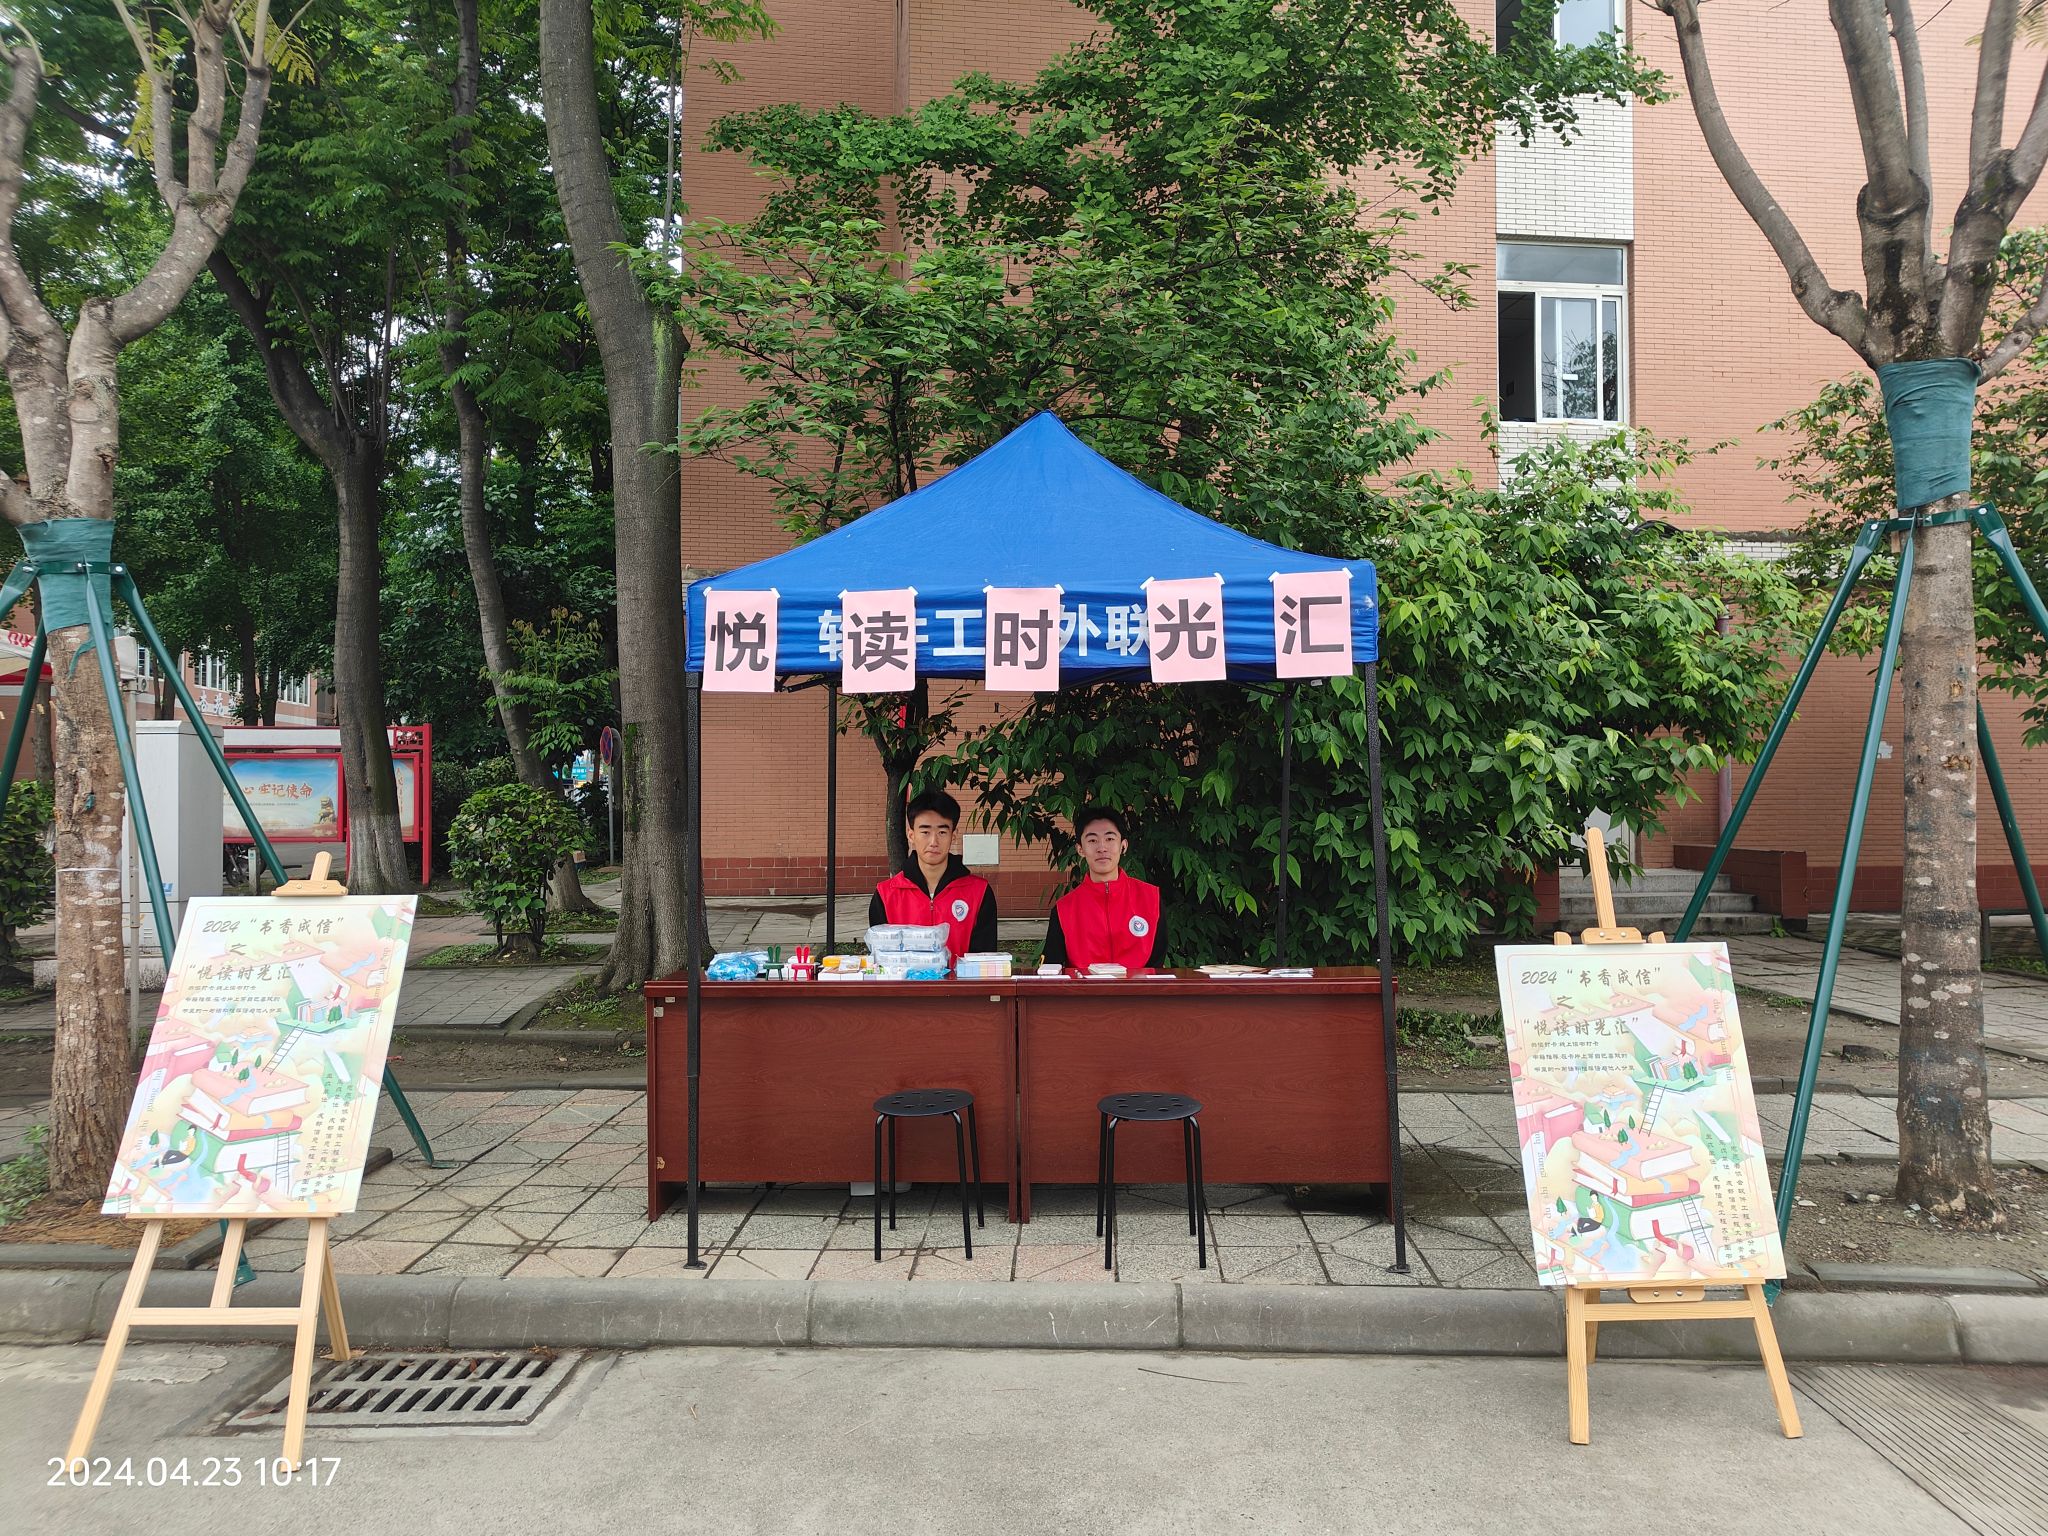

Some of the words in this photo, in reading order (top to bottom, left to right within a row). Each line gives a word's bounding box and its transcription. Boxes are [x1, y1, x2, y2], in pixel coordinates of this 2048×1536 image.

[709, 610, 770, 672] 悦
[847, 610, 909, 672] 读
[993, 609, 1054, 670] 时
[1154, 598, 1218, 662] 光
[1279, 594, 1345, 655] 汇
[258, 782, 313, 800] 牢记使命
[202, 920, 241, 933] 2024
[229, 943, 247, 955] 之
[1520, 971, 1558, 985] 2024
[1566, 967, 1661, 987] “书香成信”
[1556, 995, 1575, 1010] 之
[1523, 1016, 1639, 1037] “悦读时光汇”
